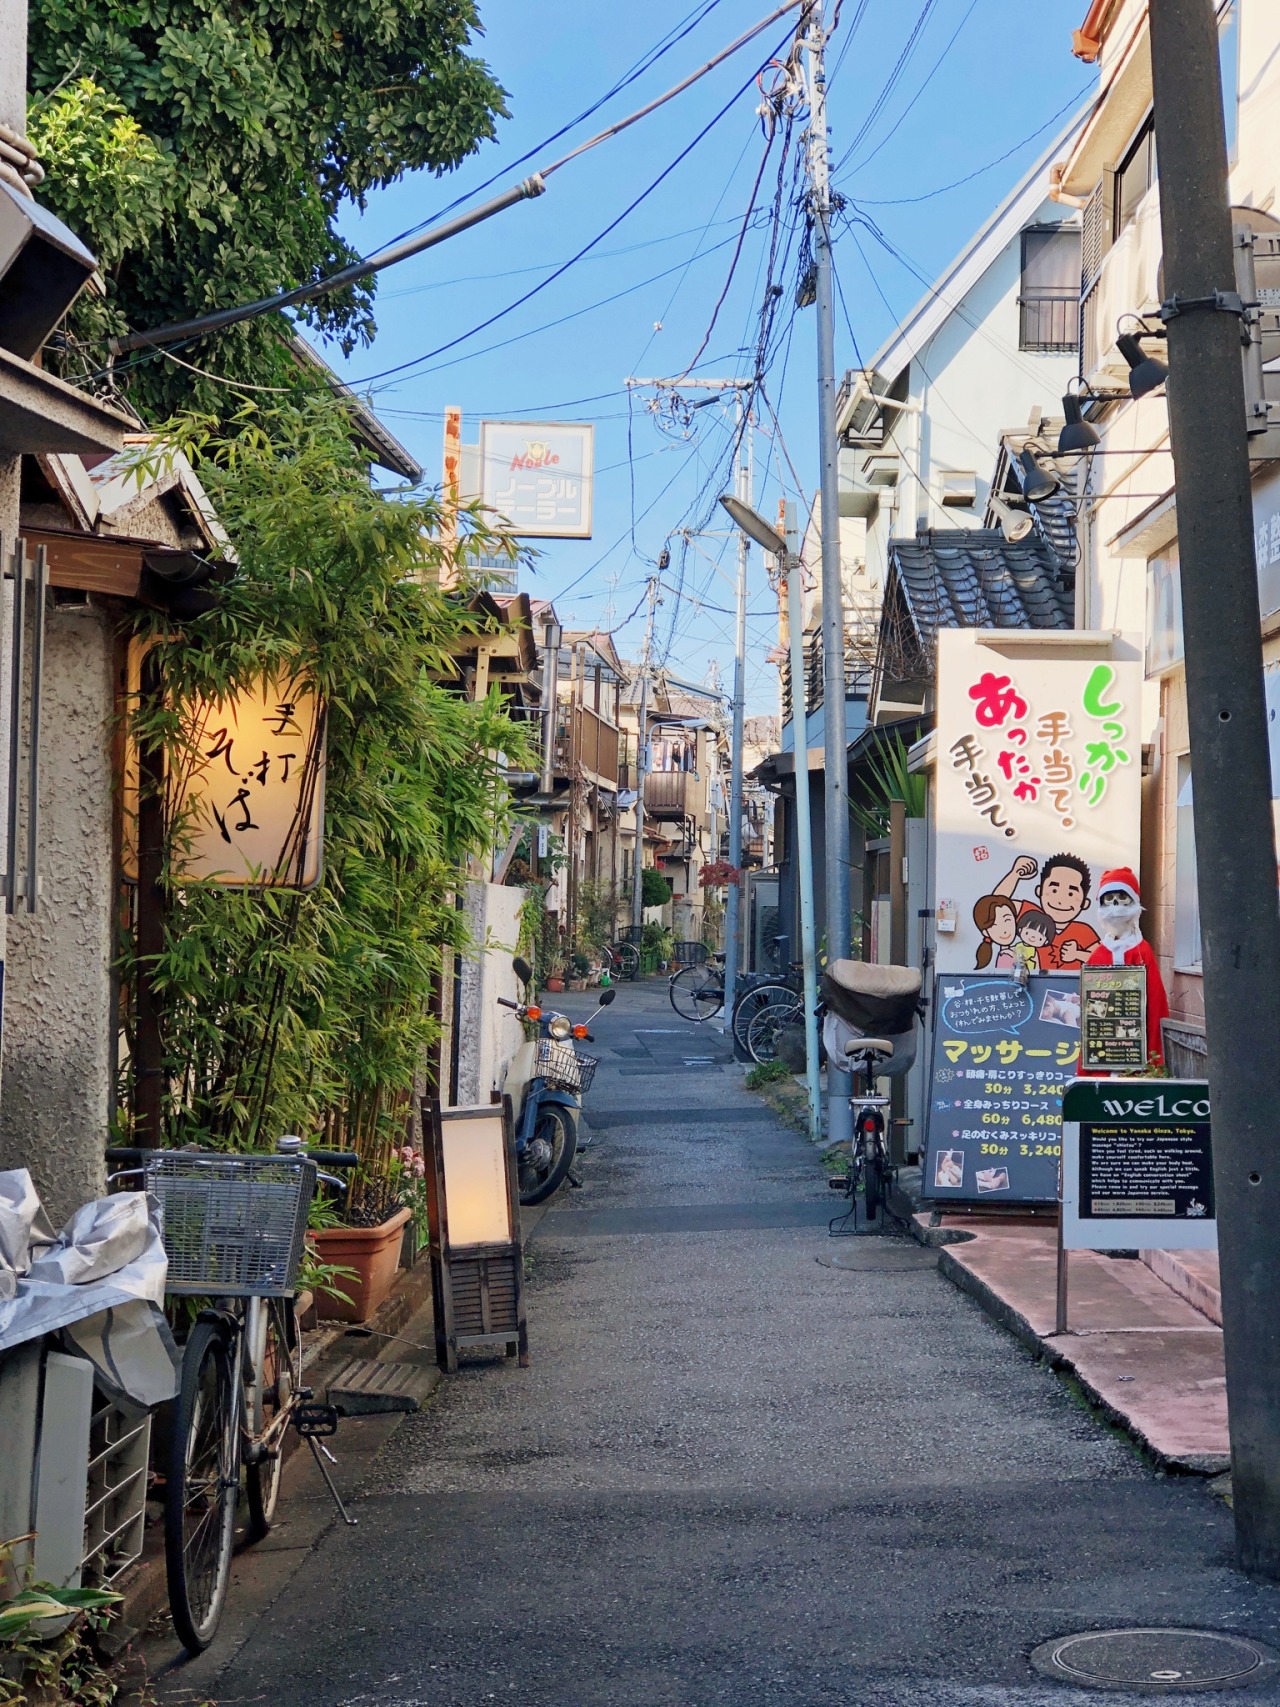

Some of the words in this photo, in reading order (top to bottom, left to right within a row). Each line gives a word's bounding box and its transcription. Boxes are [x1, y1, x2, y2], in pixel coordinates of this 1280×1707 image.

[495, 477, 578, 501] ノーブル
[252, 702, 296, 786] 手打
[968, 672, 1041, 801] あったか
[1079, 664, 1129, 805] しっかり
[1037, 711, 1073, 828] 手当て。
[206, 727, 260, 844] そば
[950, 734, 1016, 837] 手当て。
[1090, 991, 1110, 999] Body
[943, 1040, 1080, 1066] マッサージ
[984, 1083, 1012, 1095] 30分
[963, 1099, 1049, 1110] 全身みっちりコース
[982, 1113, 1011, 1125] 60分
[980, 1143, 1008, 1155] 30分
